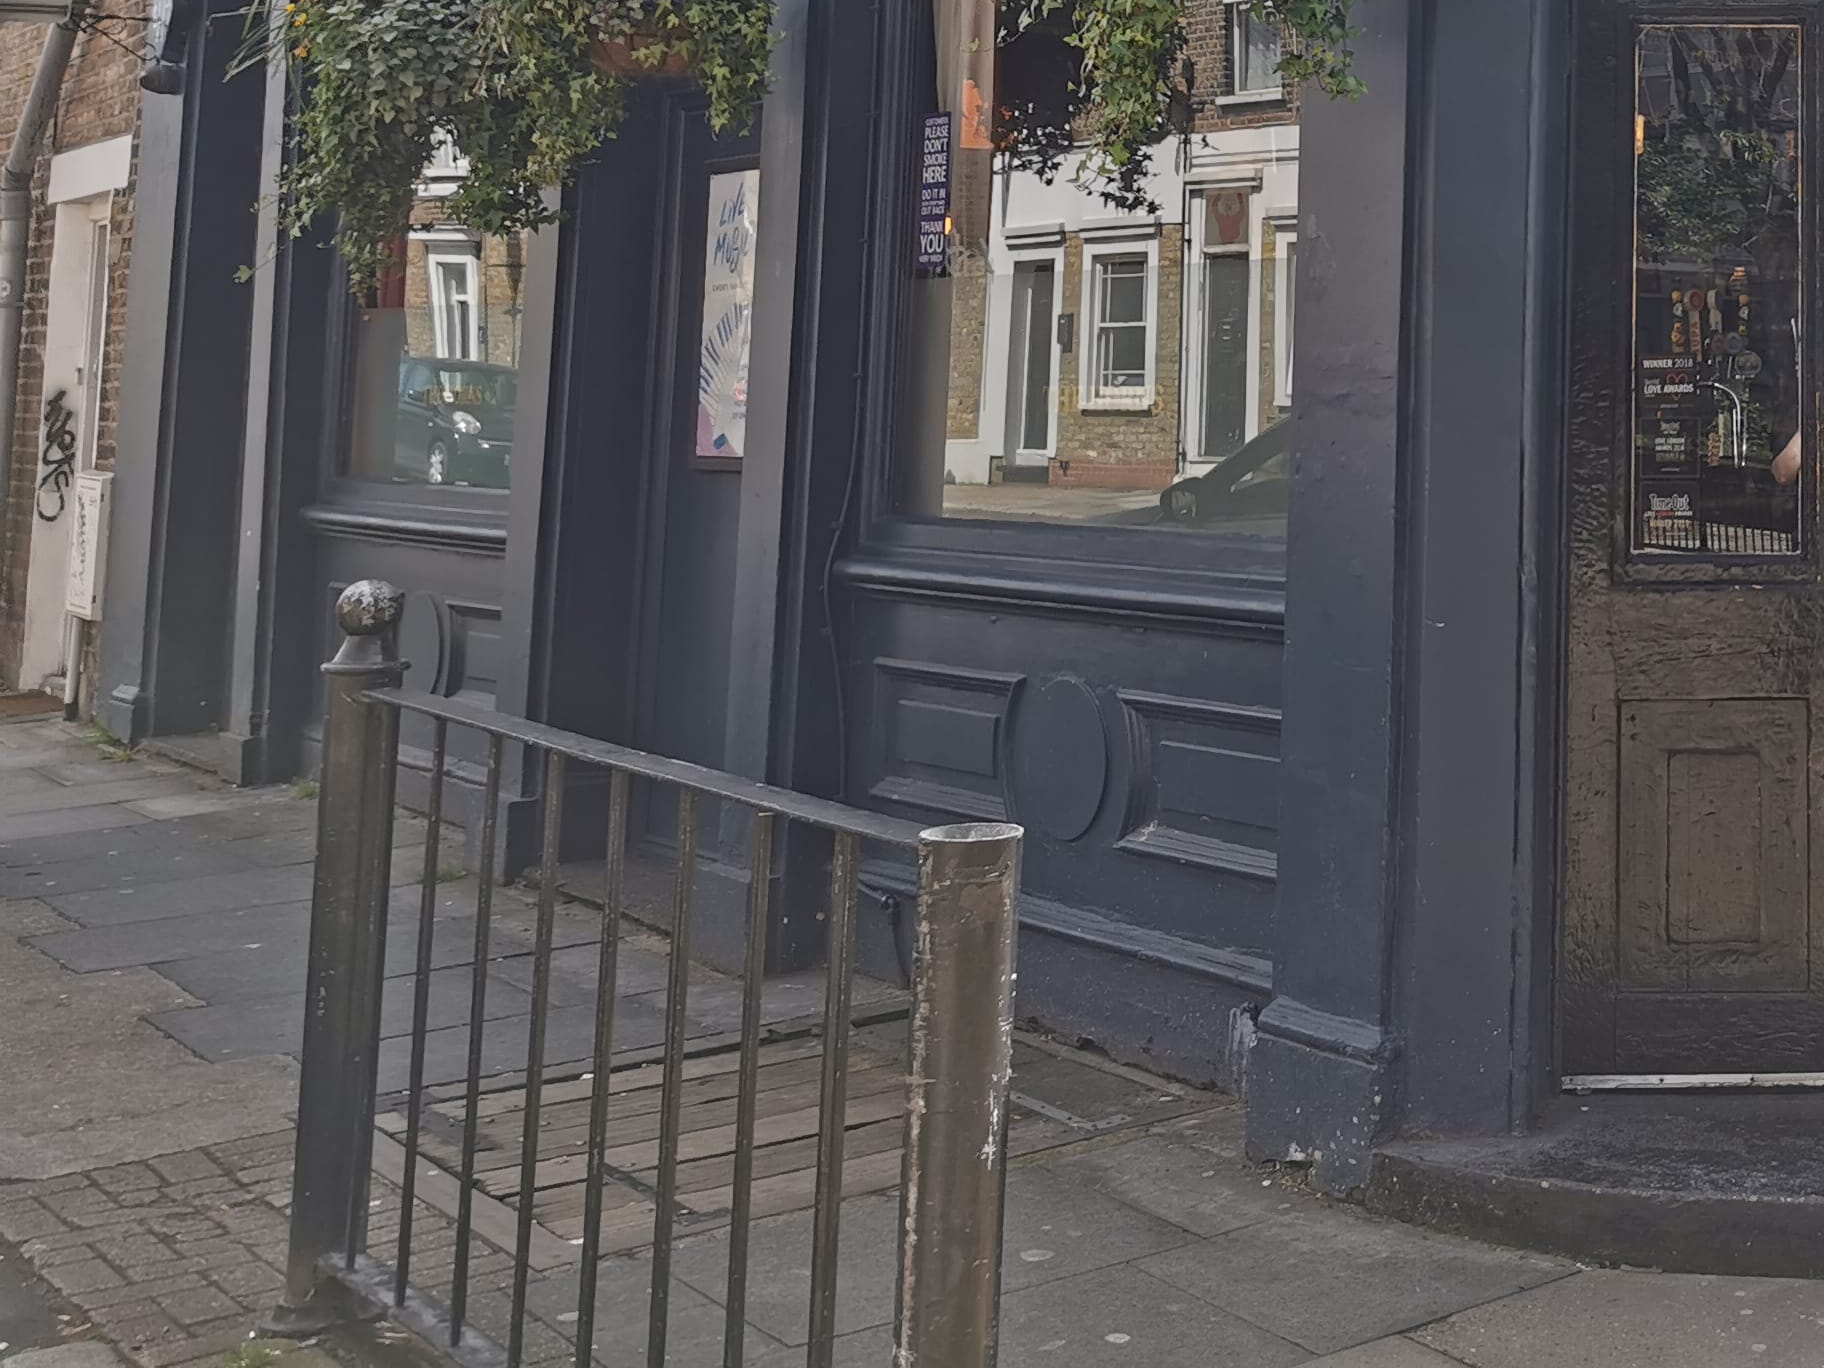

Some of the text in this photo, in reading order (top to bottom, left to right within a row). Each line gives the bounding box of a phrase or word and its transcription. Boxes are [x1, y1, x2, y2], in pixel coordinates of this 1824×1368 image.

[924, 125, 950, 139] PLEASE
[923, 152, 948, 166] SMOKE
[922, 165, 948, 184] HERE
[922, 189, 931, 201] DO
[920, 233, 944, 253] YOU
[1642, 359, 1673, 369] WINNER
